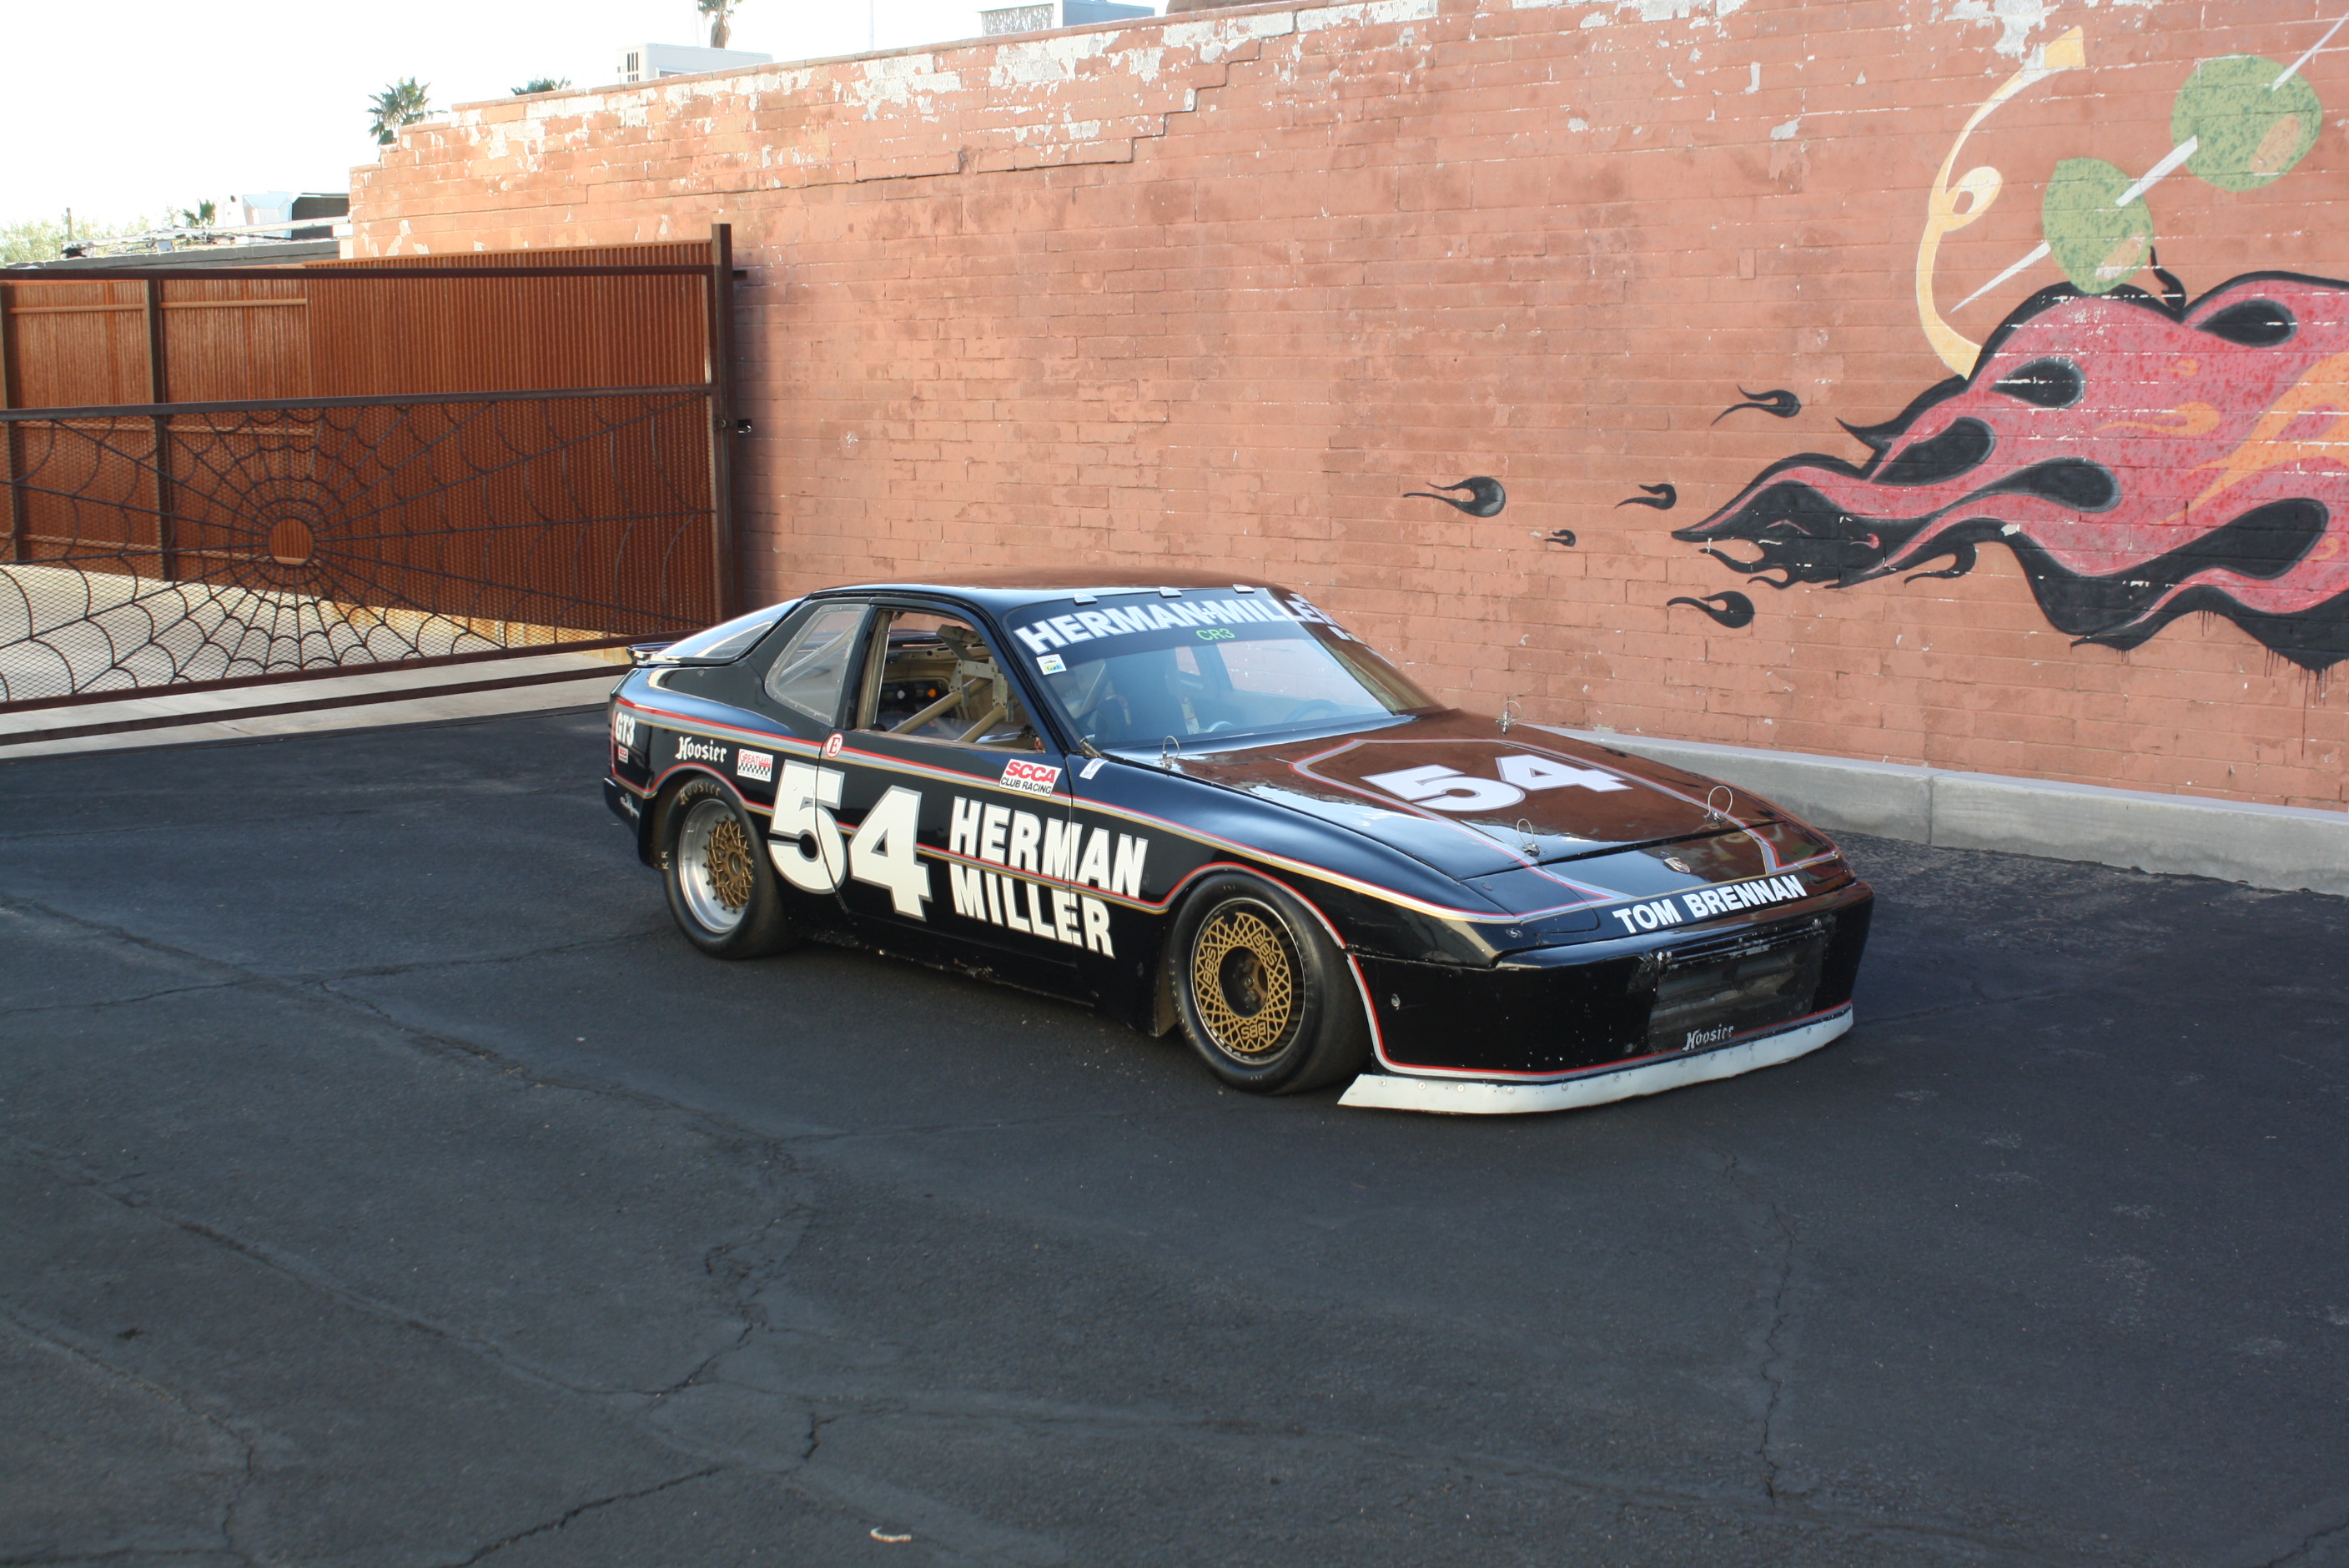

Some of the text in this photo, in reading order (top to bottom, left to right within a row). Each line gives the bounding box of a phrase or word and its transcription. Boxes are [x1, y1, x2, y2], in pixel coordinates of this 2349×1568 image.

[1195, 627, 1235, 641] CR3
[616, 711, 636, 746] GT3
[674, 736, 727, 763] Hoosier
[1000, 776, 1052, 795] CLUB RACING
[1005, 761, 1057, 784] SCCA
[1361, 753, 1633, 812] 54
[767, 758, 933, 922] 54
[948, 795, 1149, 899] HERMAN
[948, 860, 1116, 959] MILLER
[1612, 874, 1808, 934] TOM BRENNAN
[1251, 932, 1278, 966] BBS
[1202, 947, 1217, 986] BBS
[1240, 1021, 1267, 1040] BBS
[1681, 1023, 1734, 1052] Hoosier
